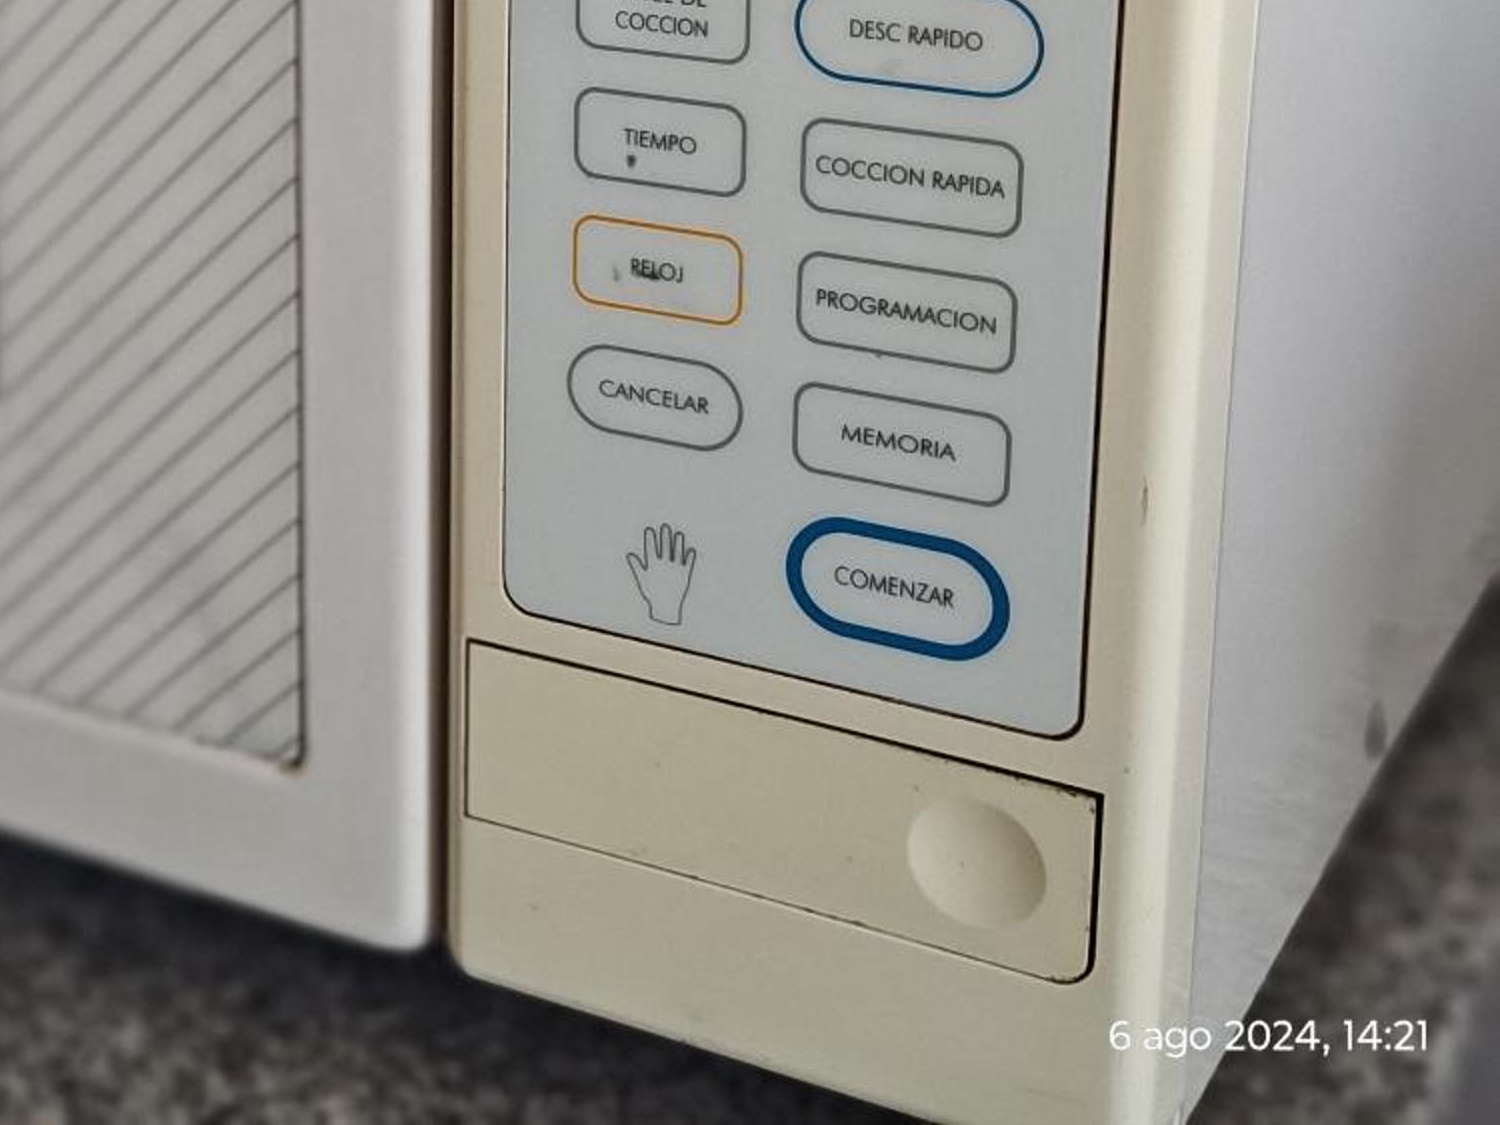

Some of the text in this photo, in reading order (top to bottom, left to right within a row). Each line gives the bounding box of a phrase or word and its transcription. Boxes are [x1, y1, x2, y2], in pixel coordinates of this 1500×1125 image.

[615, 11, 709, 38] COCCION
[849, 18, 983, 51] DESC RAPIDO
[623, 128, 697, 154] TIEMPO
[815, 155, 1005, 199] COCCION RAPIDA
[630, 257, 684, 283] RELOJ
[816, 289, 997, 334] PROGRAMACION
[598, 379, 709, 414] CANCELAR
[840, 424, 956, 461] MEMORIA
[833, 565, 954, 608] COMENZAR
